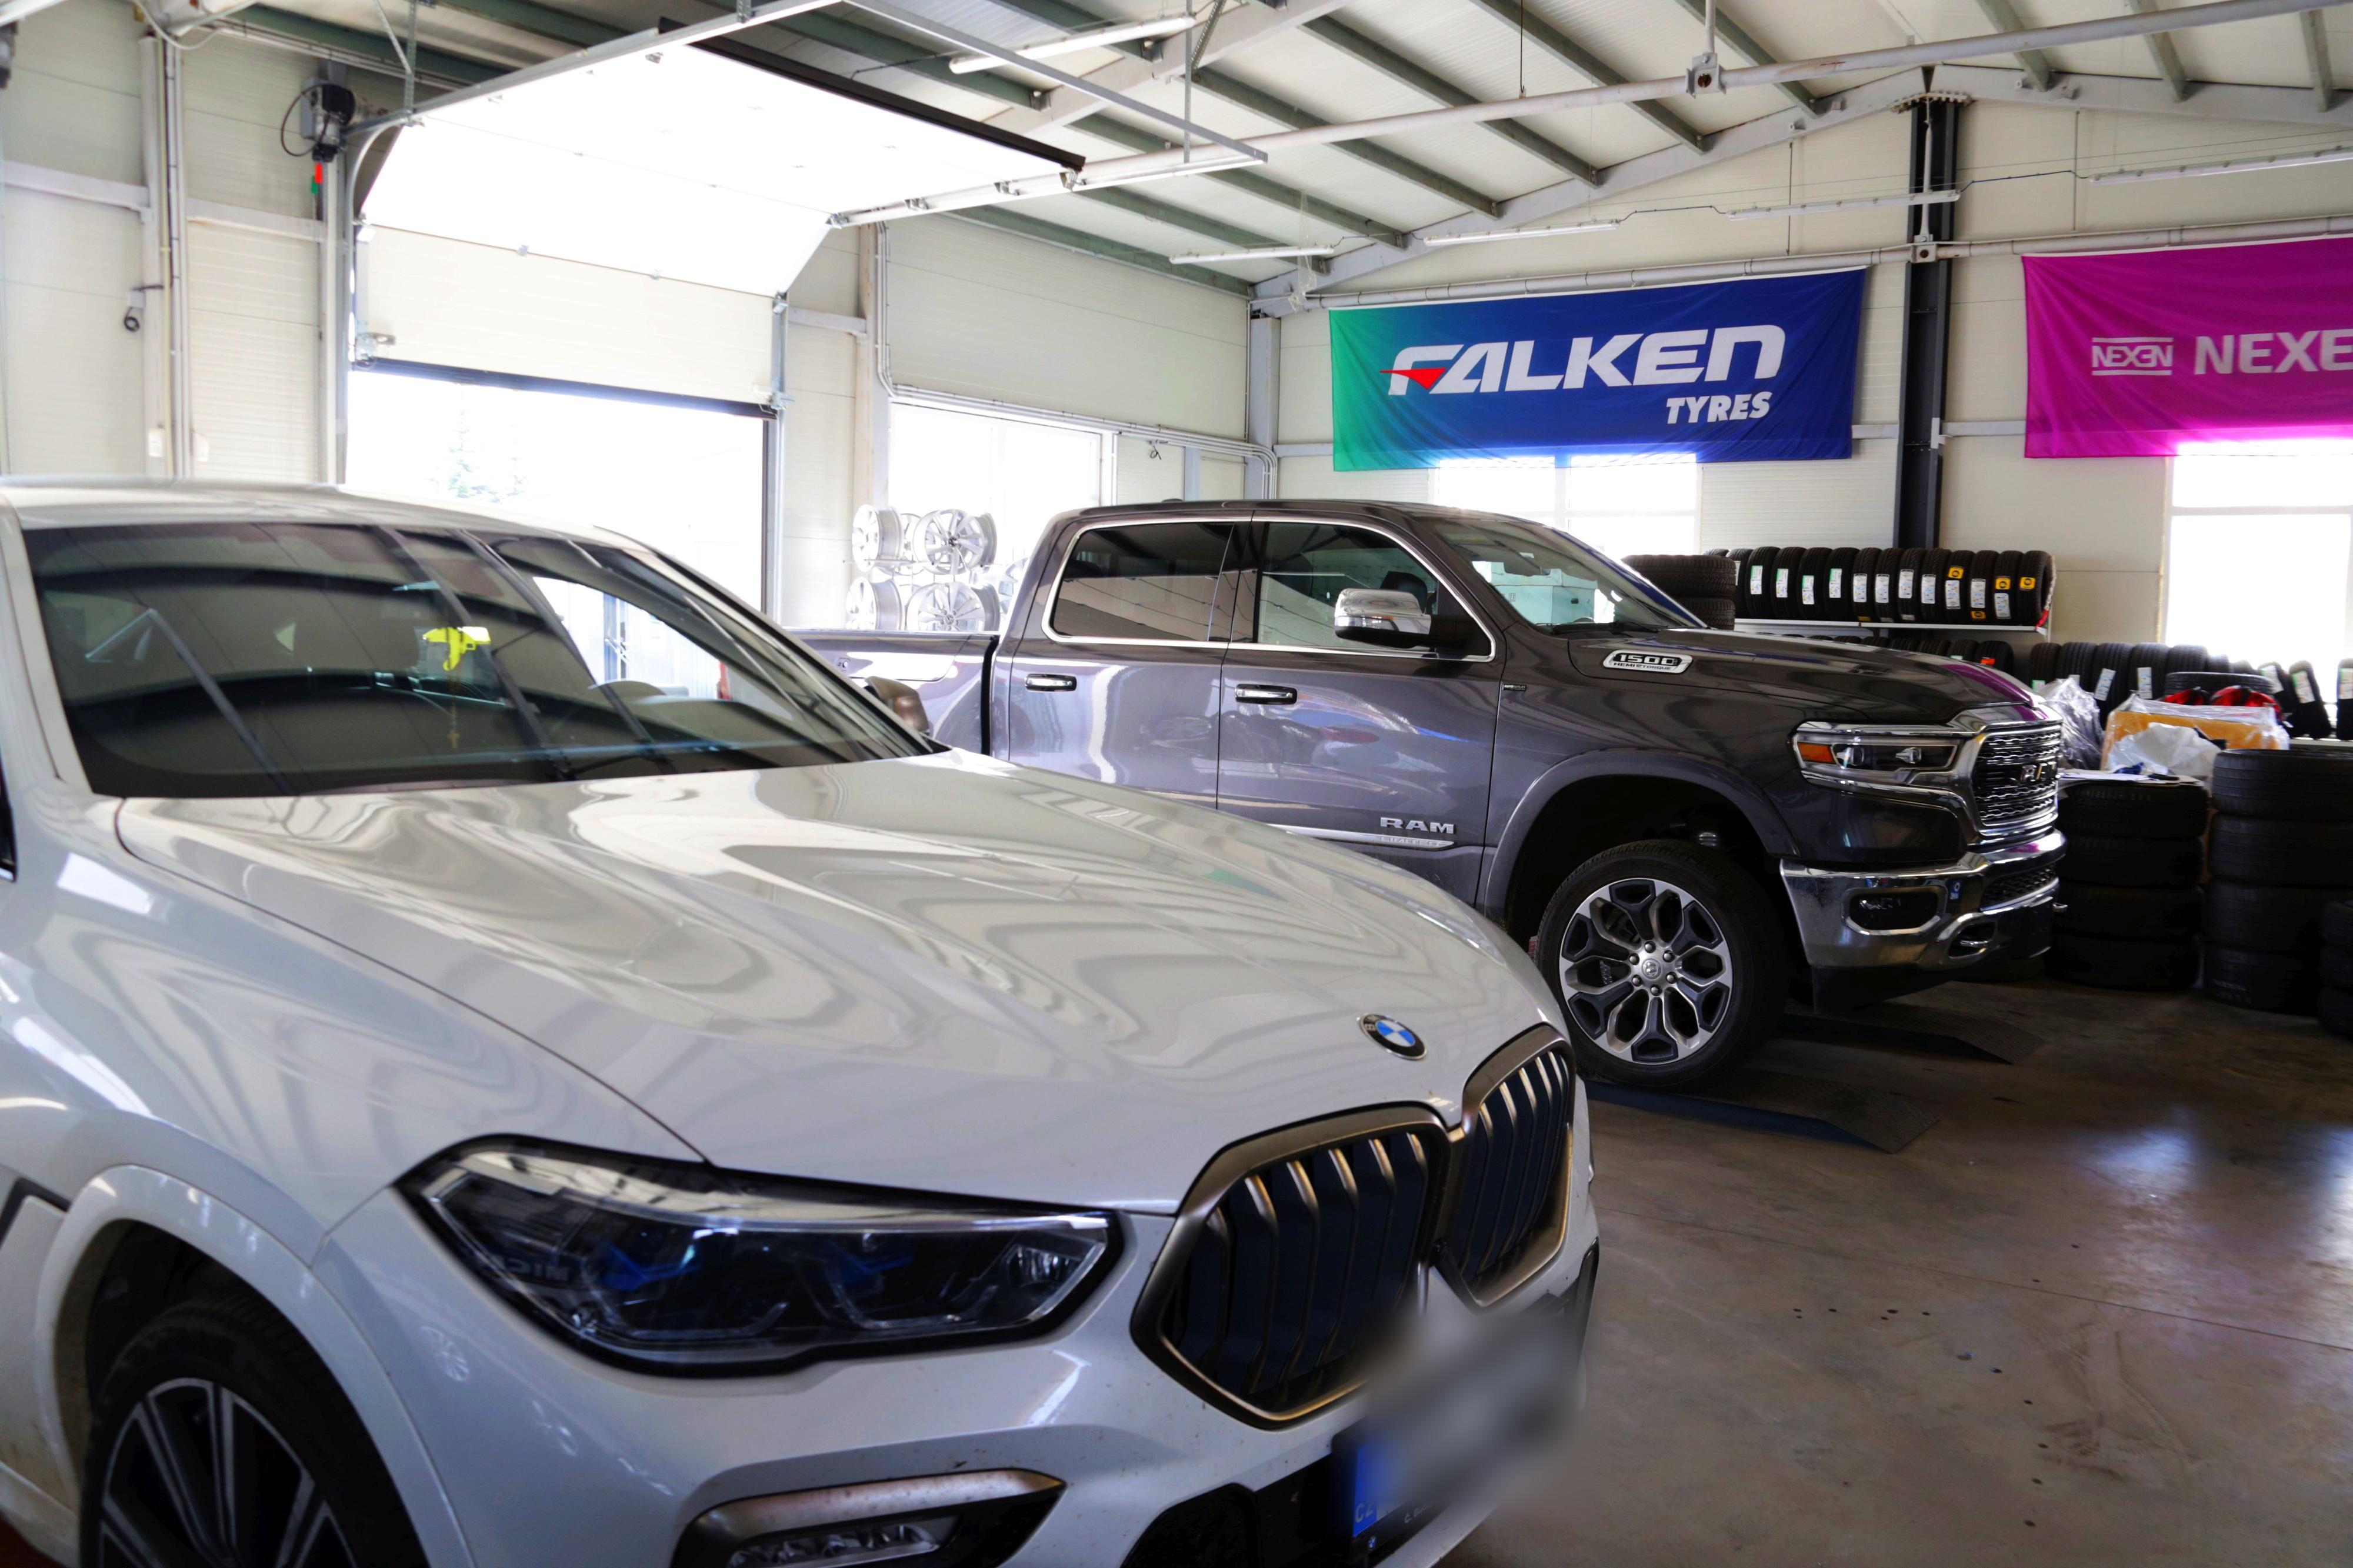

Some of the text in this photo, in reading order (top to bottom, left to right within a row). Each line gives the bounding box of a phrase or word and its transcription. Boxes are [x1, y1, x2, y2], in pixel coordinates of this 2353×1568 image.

[1379, 324, 1786, 396] FALKEN
[2092, 345, 2174, 368] NEXEN
[1666, 391, 1773, 425] TYRES
[1619, 654, 1675, 665] 1500
[1380, 816, 1455, 835] RAM
